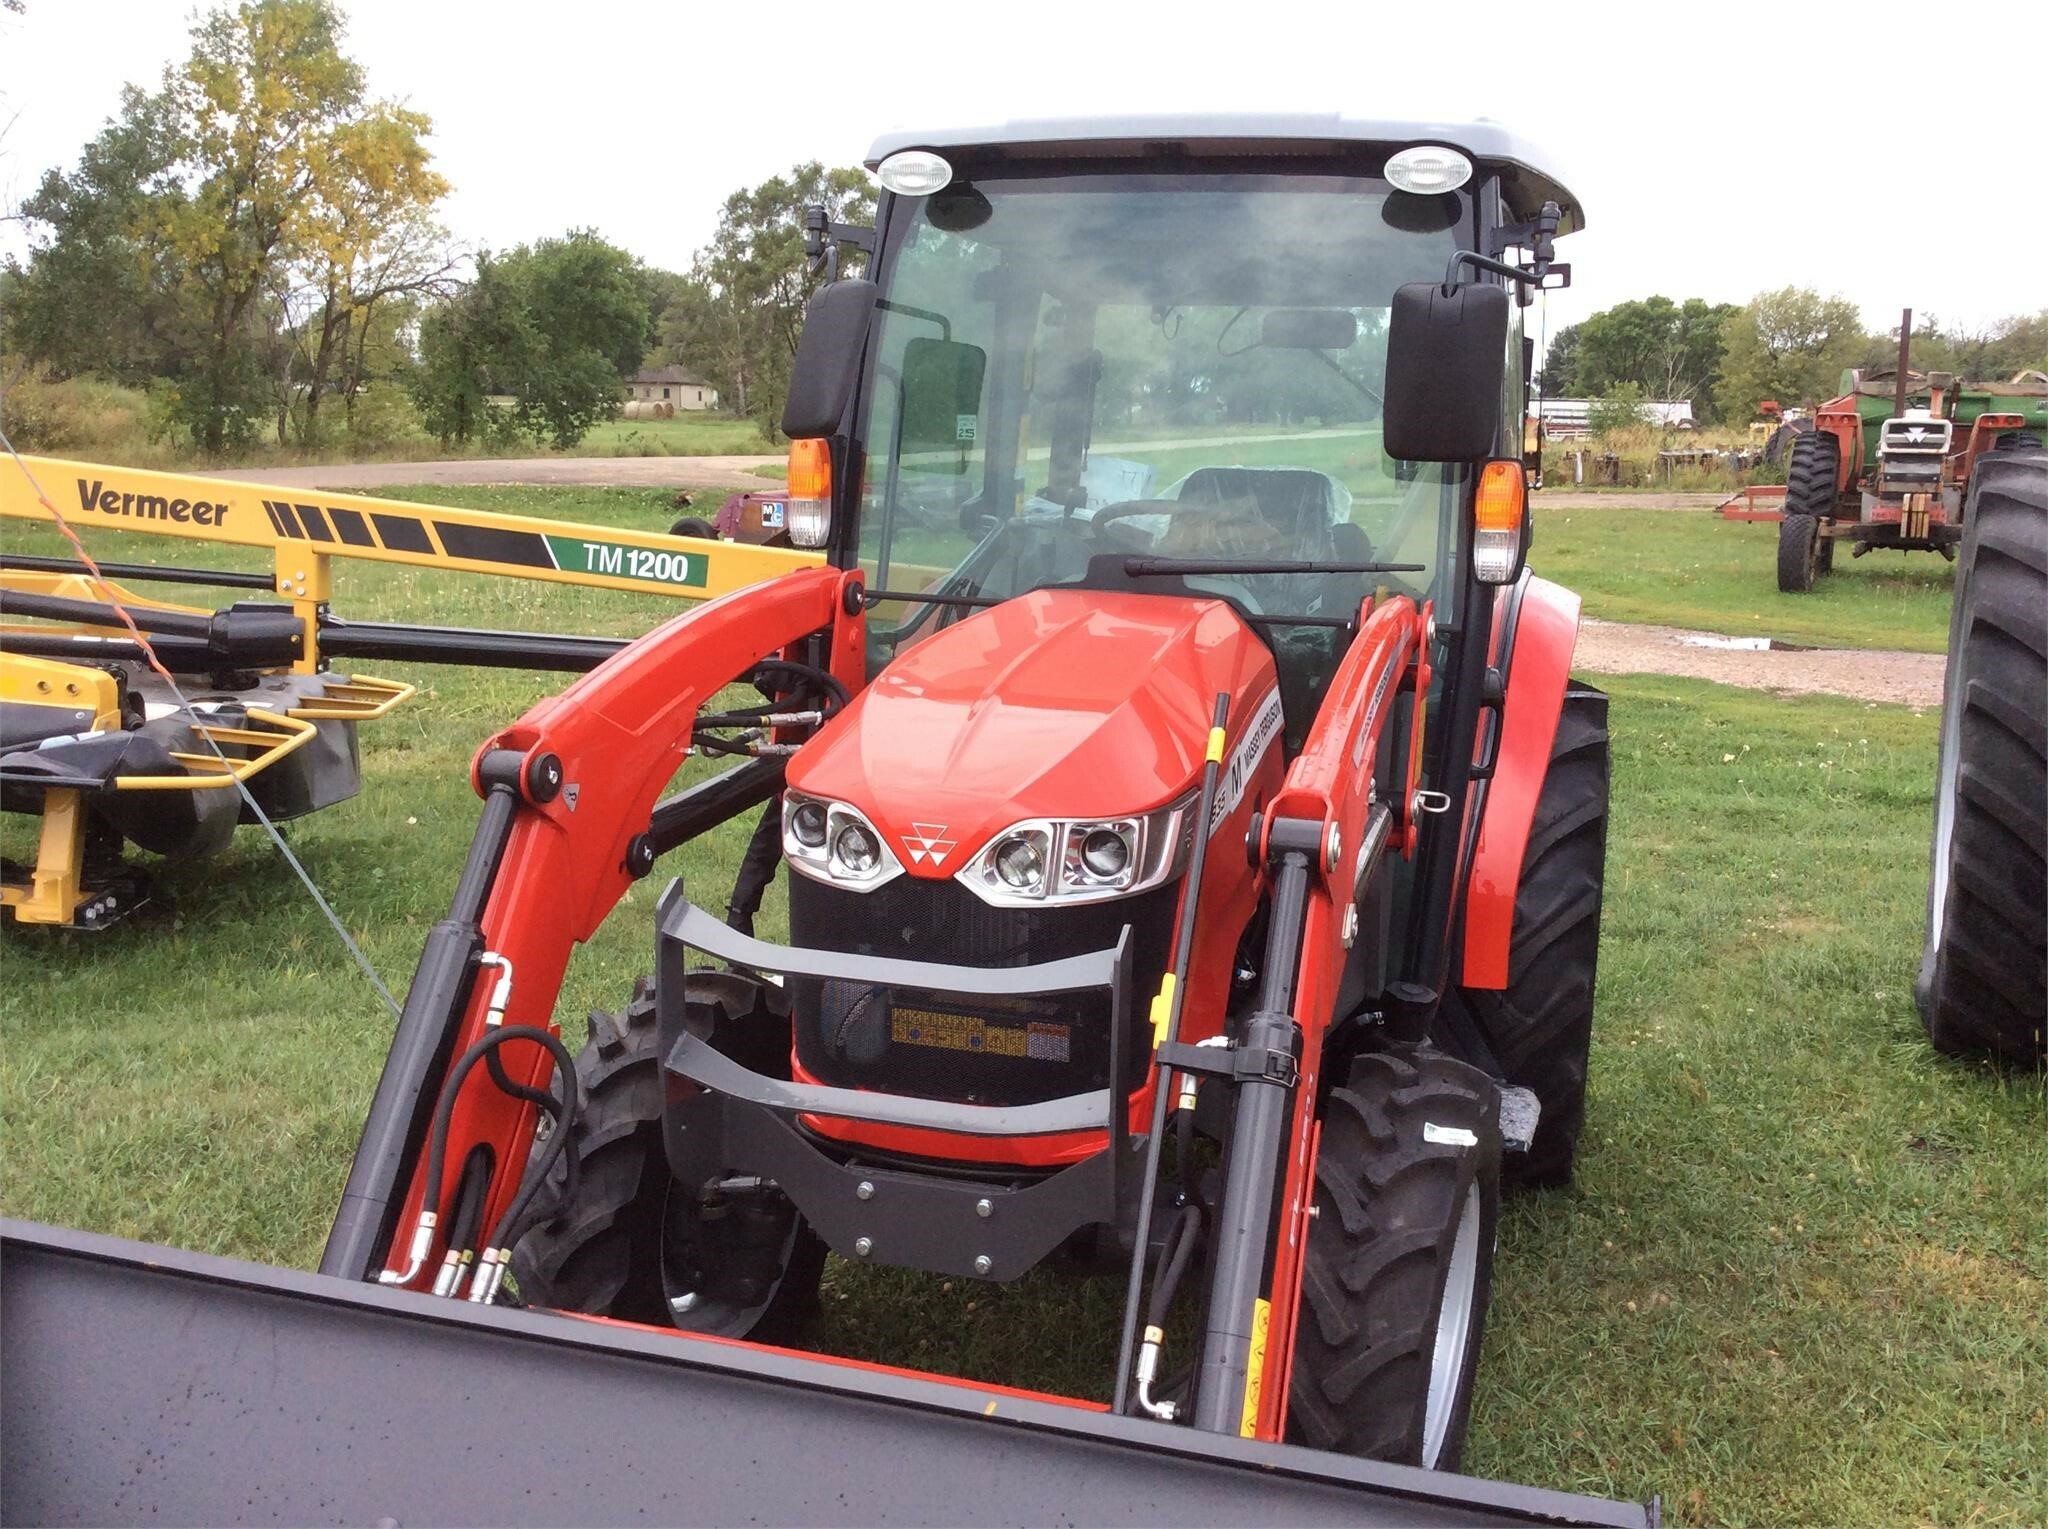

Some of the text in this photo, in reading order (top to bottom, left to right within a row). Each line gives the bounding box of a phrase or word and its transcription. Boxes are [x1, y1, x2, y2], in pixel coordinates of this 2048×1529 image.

[77, 478, 229, 527] Vermeer
[583, 543, 689, 582] TM 1200
